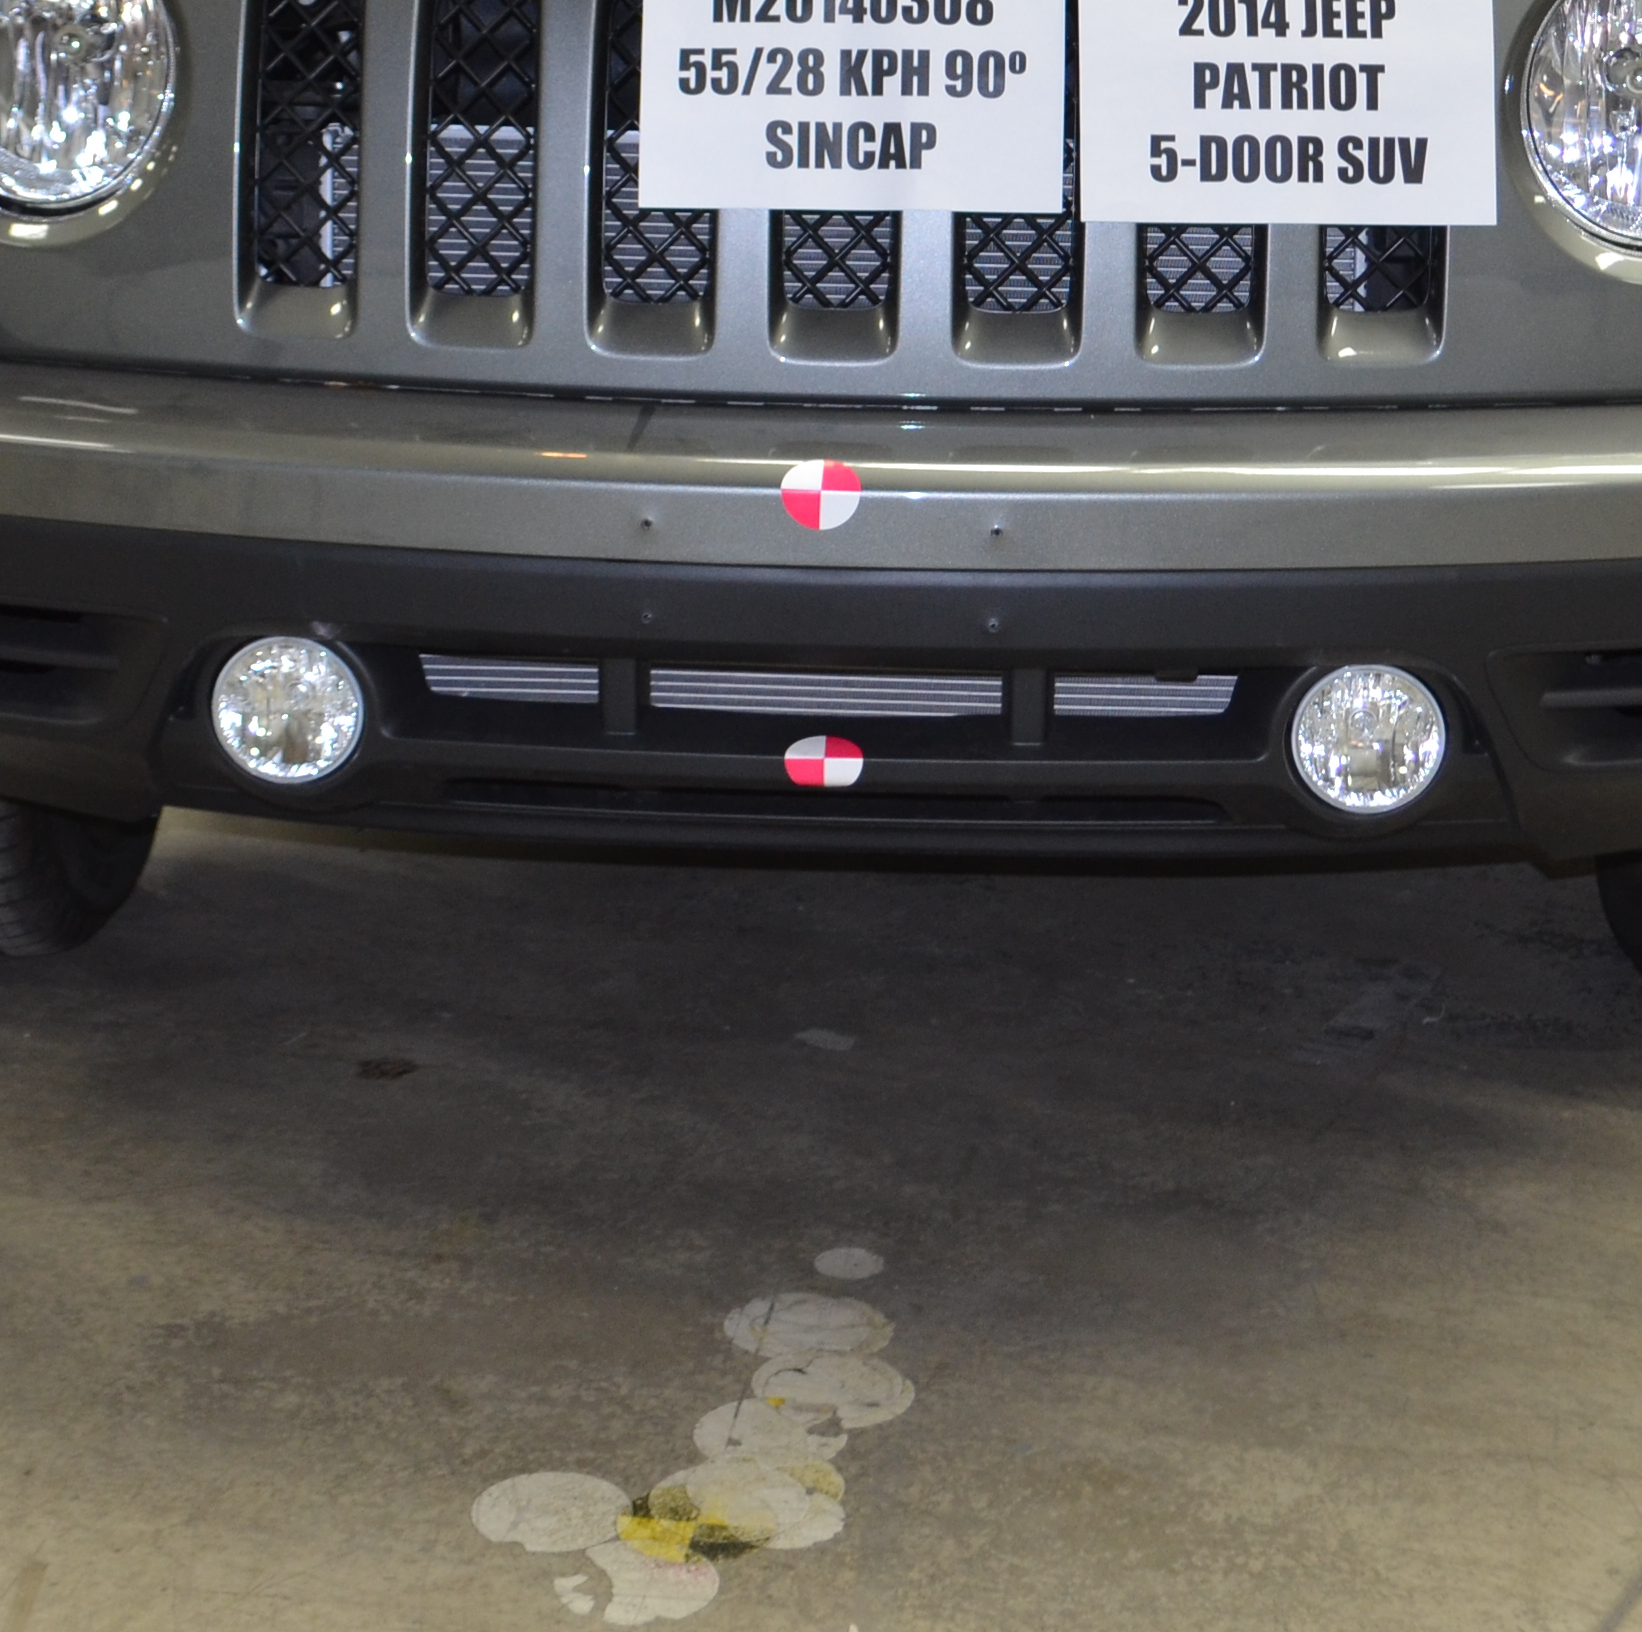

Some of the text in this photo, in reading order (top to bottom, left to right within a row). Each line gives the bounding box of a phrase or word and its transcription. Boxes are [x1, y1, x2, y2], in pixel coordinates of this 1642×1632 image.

[679, 48, 824, 96] 55/28
[840, 50, 929, 96] KPH
[1194, 63, 1385, 111] PATRIOT
[767, 121, 936, 170] SINCAP
[1151, 135, 1427, 184] 5-DOOR SUV
